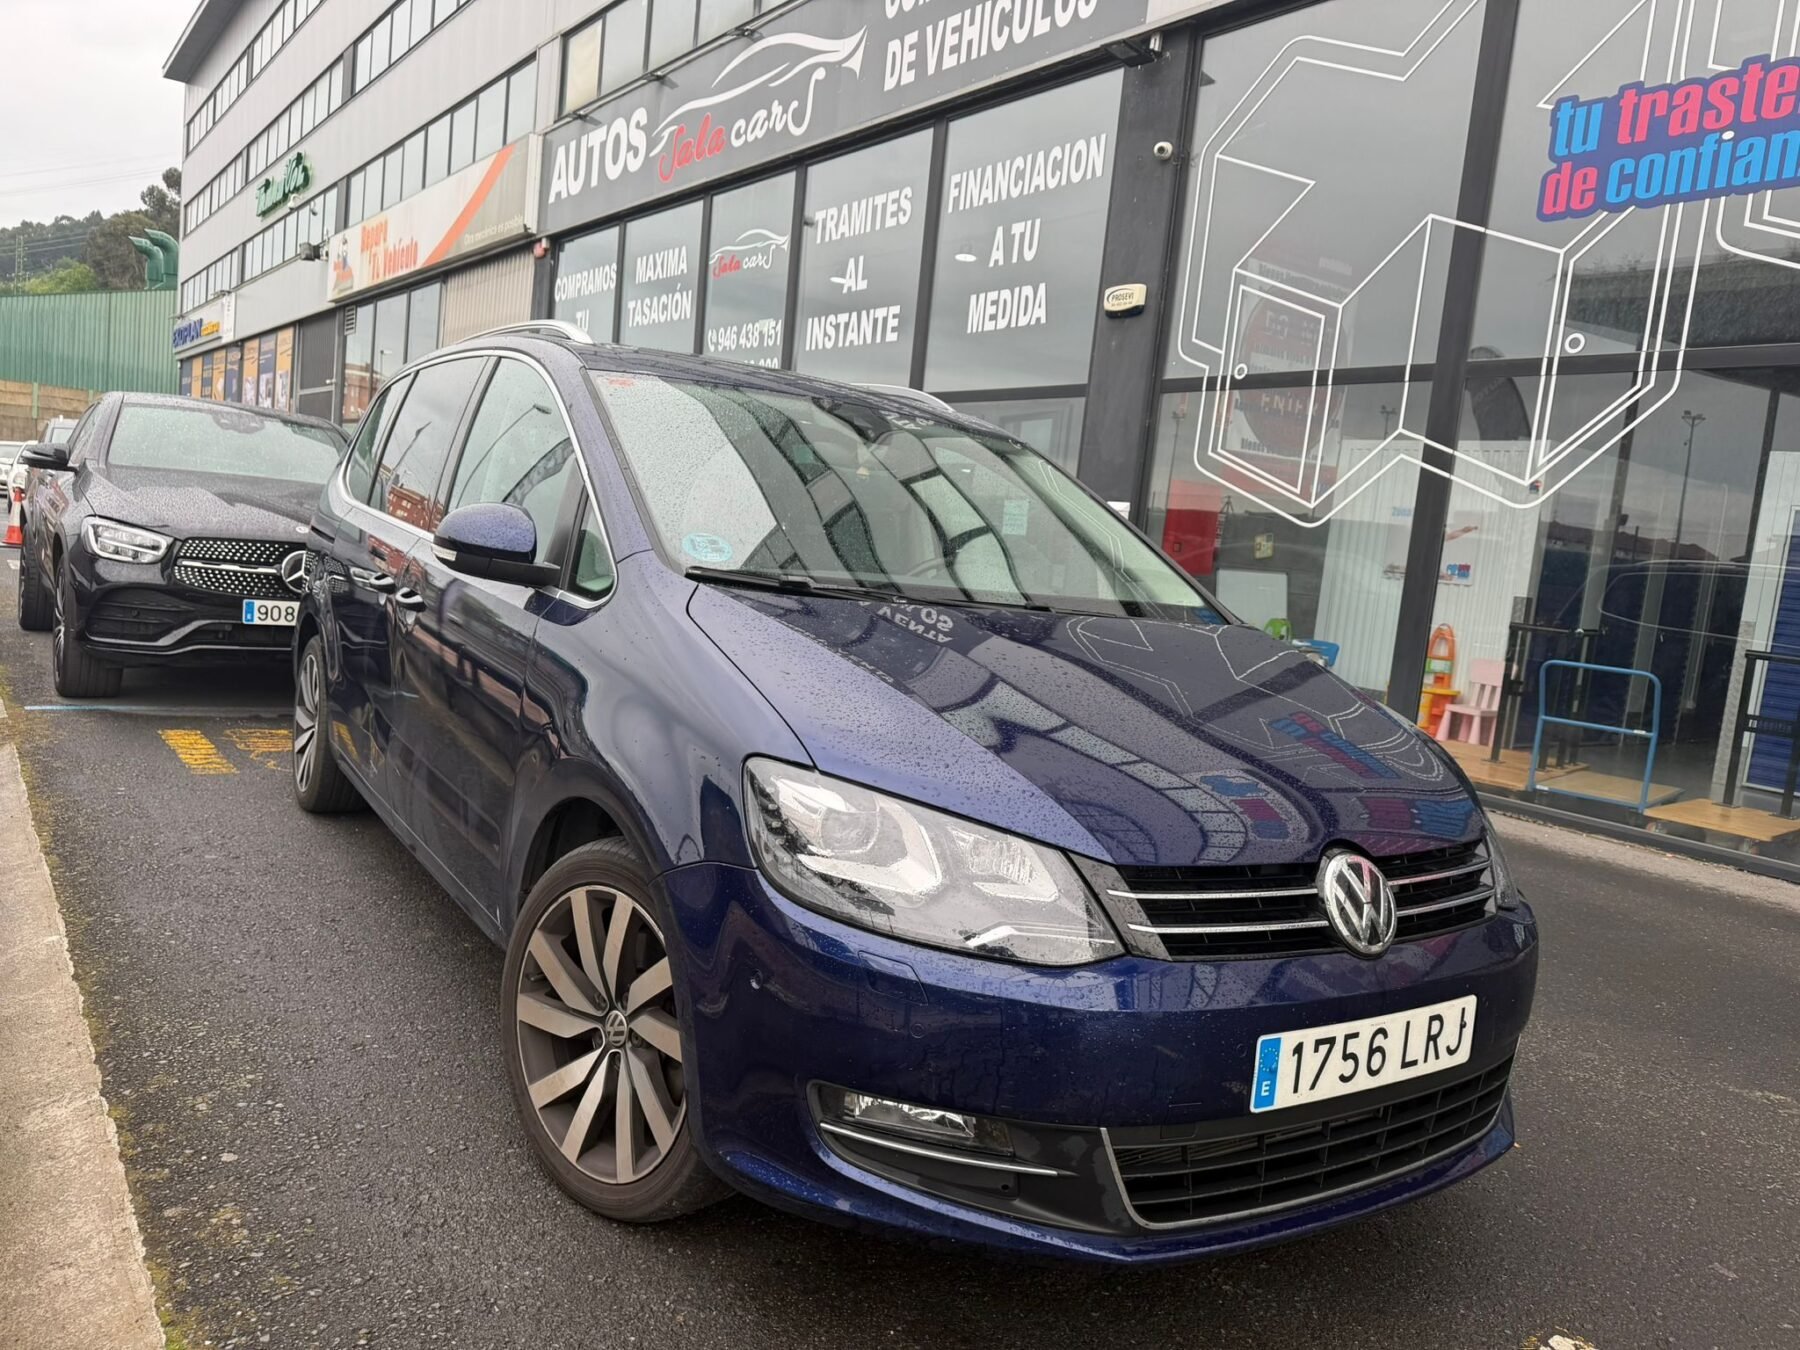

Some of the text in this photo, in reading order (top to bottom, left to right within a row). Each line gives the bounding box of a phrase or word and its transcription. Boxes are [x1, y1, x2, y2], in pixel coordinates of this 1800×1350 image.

[884, 30, 919, 92] DE
[1555, 63, 1800, 157] tu traste
[548, 106, 648, 203] AUTOS
[947, 134, 1107, 213] FINANCIACION
[1542, 129, 1800, 215] de confian
[814, 186, 912, 245] TRAMITES
[636, 246, 687, 284] MAXIMA
[988, 218, 1041, 268] A TU
[555, 263, 617, 302] COMPRAMOS
[843, 256, 868, 295] AL
[628, 283, 692, 327] TASACIÓN
[805, 304, 900, 351] INSTANTE
[967, 282, 1047, 333] MEDIDA
[718, 319, 782, 352] 946 438 151
[257, 604, 295, 622] 908
[1292, 1007, 1466, 1094] 1756 LRJ
[1261, 1081, 1270, 1097] E
